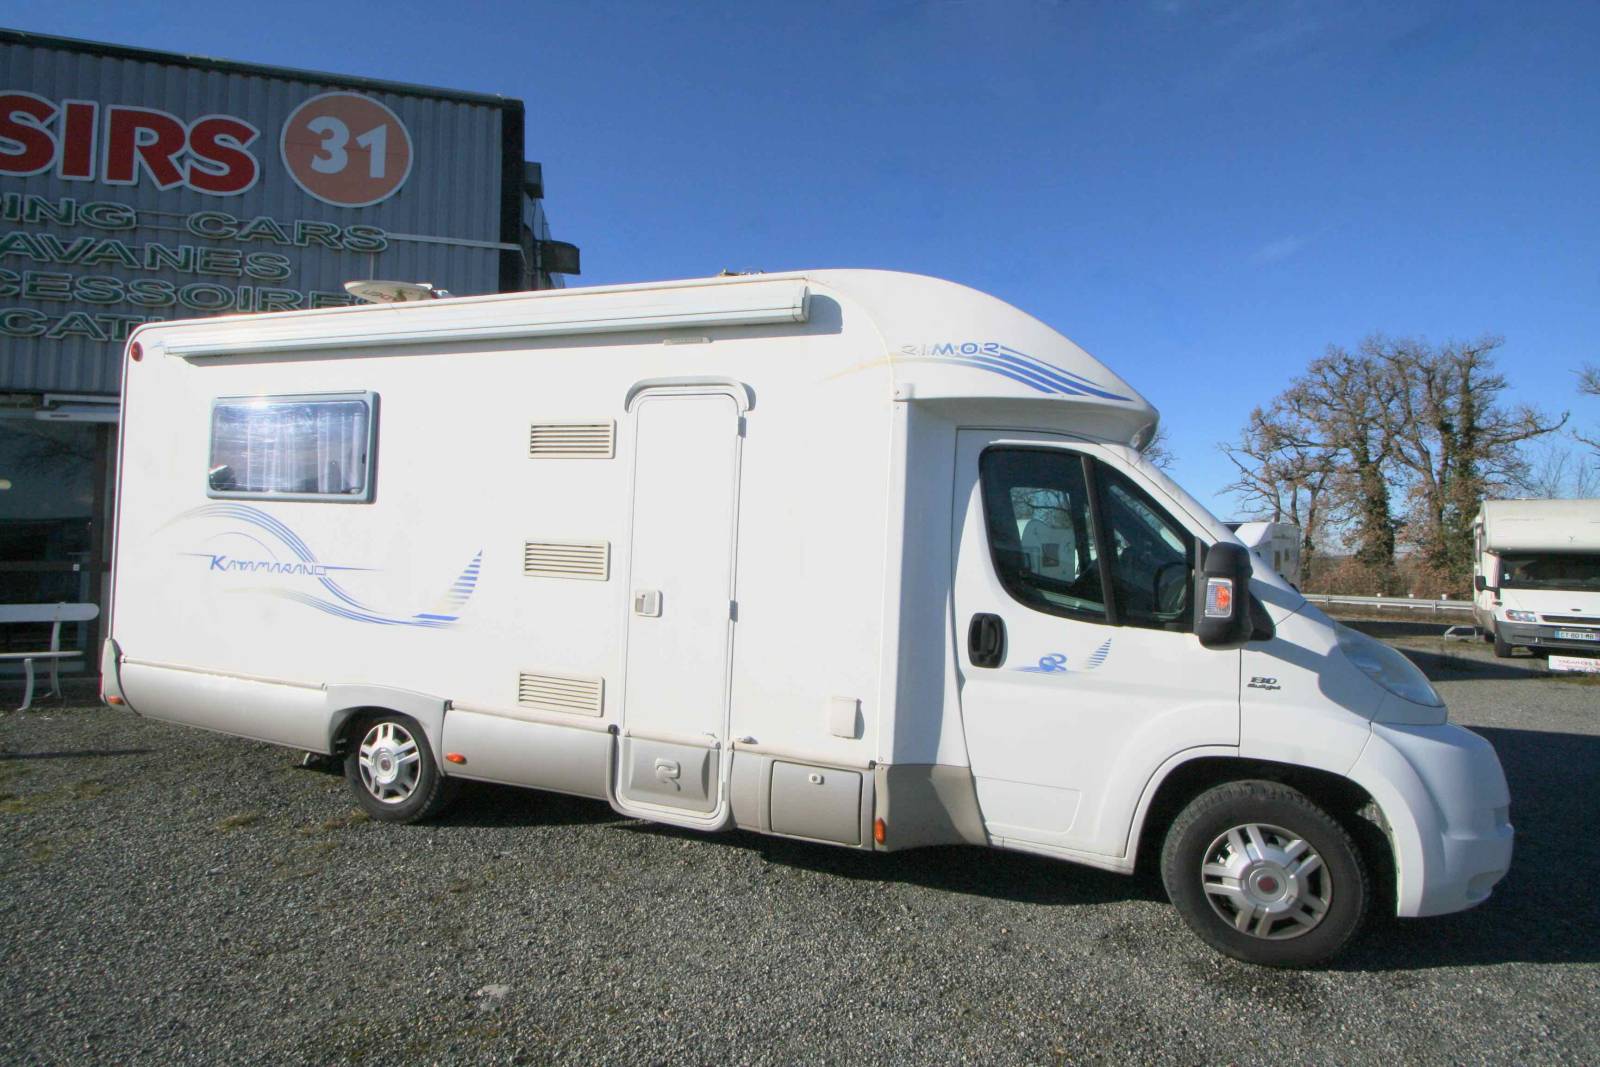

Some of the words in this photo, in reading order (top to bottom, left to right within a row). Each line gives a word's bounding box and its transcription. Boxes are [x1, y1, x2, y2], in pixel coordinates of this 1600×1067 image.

[0, 90, 260, 196] SIRS
[305, 115, 388, 179] 31
[3, 193, 137, 230] ING
[187, 211, 388, 252] CARS
[0, 231, 292, 280] AVANES
